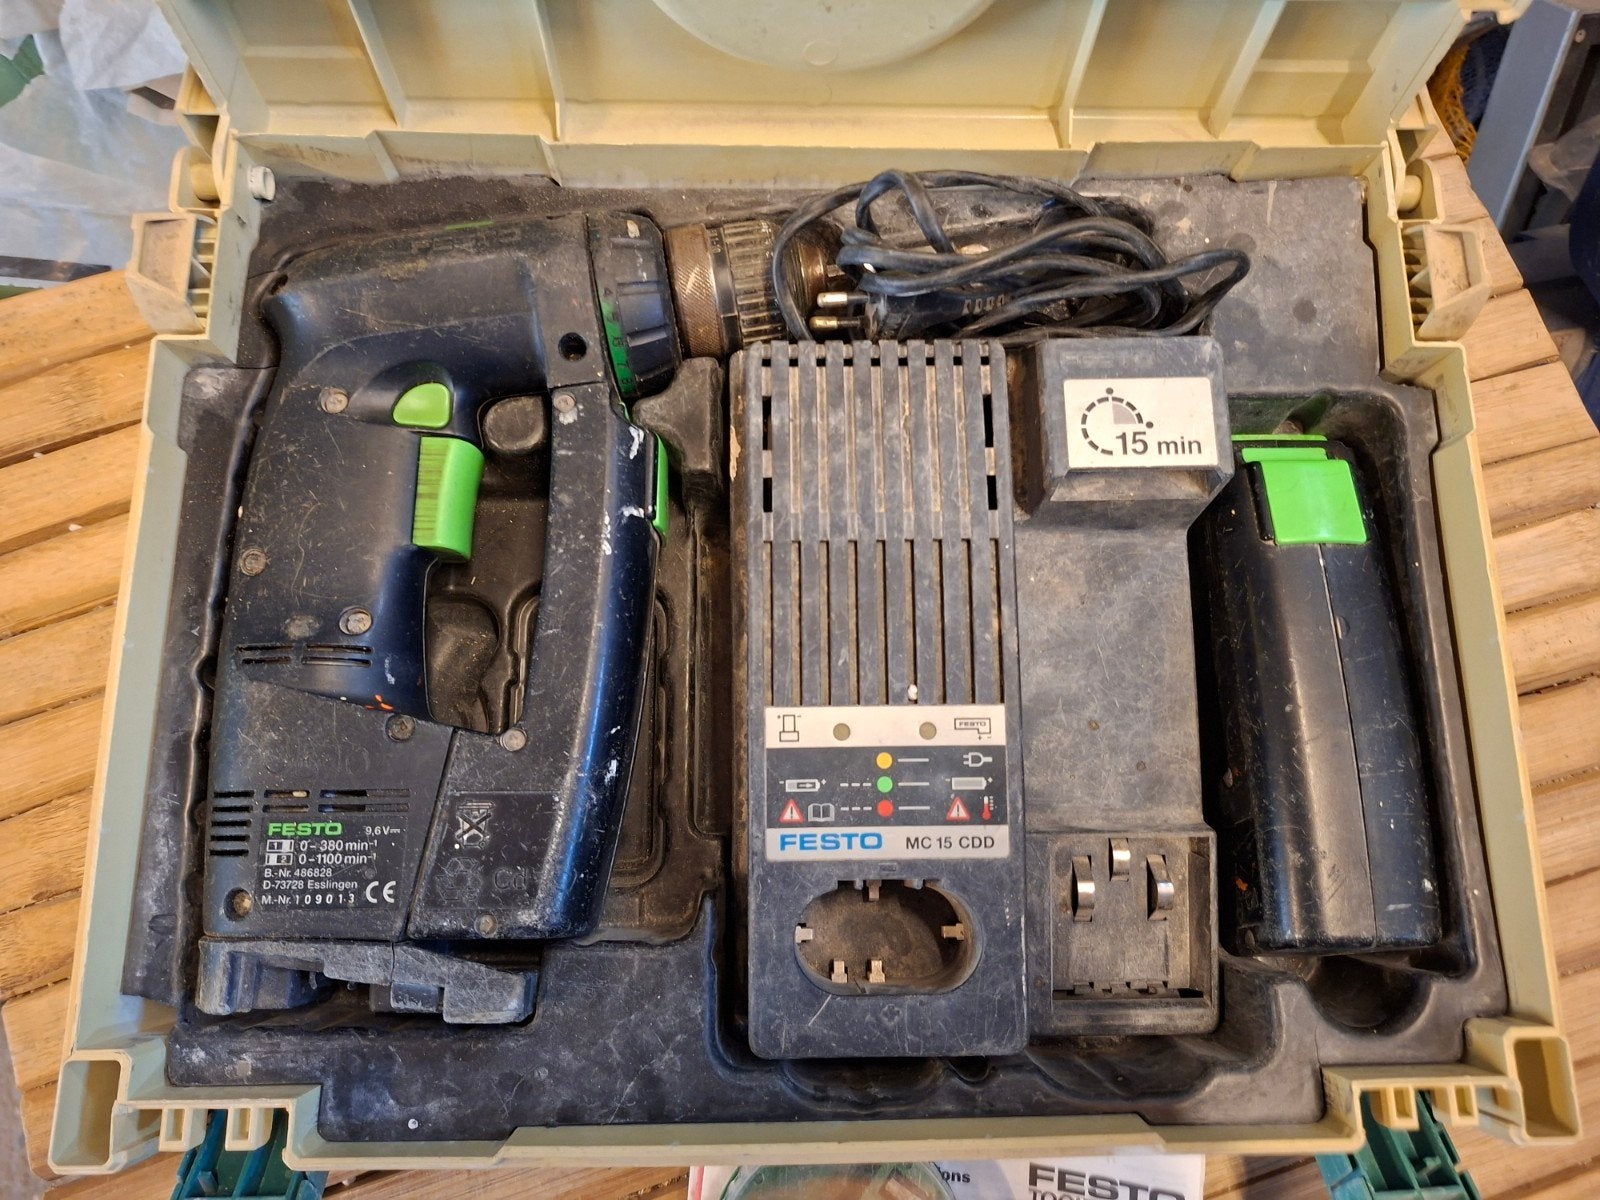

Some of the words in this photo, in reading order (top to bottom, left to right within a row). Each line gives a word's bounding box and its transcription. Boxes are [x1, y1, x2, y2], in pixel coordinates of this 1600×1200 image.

[1116, 431, 1149, 455] 15
[1157, 436, 1202, 455] min
[267, 823, 342, 836] FESTO
[780, 832, 883, 851] FESTO
[906, 836, 932, 849] MC
[936, 836, 953, 849] 15
[959, 836, 995, 849] CDD
[294, 868, 332, 877] 486828
[263, 880, 304, 890] D-73728
[307, 880, 358, 891] Esslingen
[940, 1170, 970, 1183] ons
